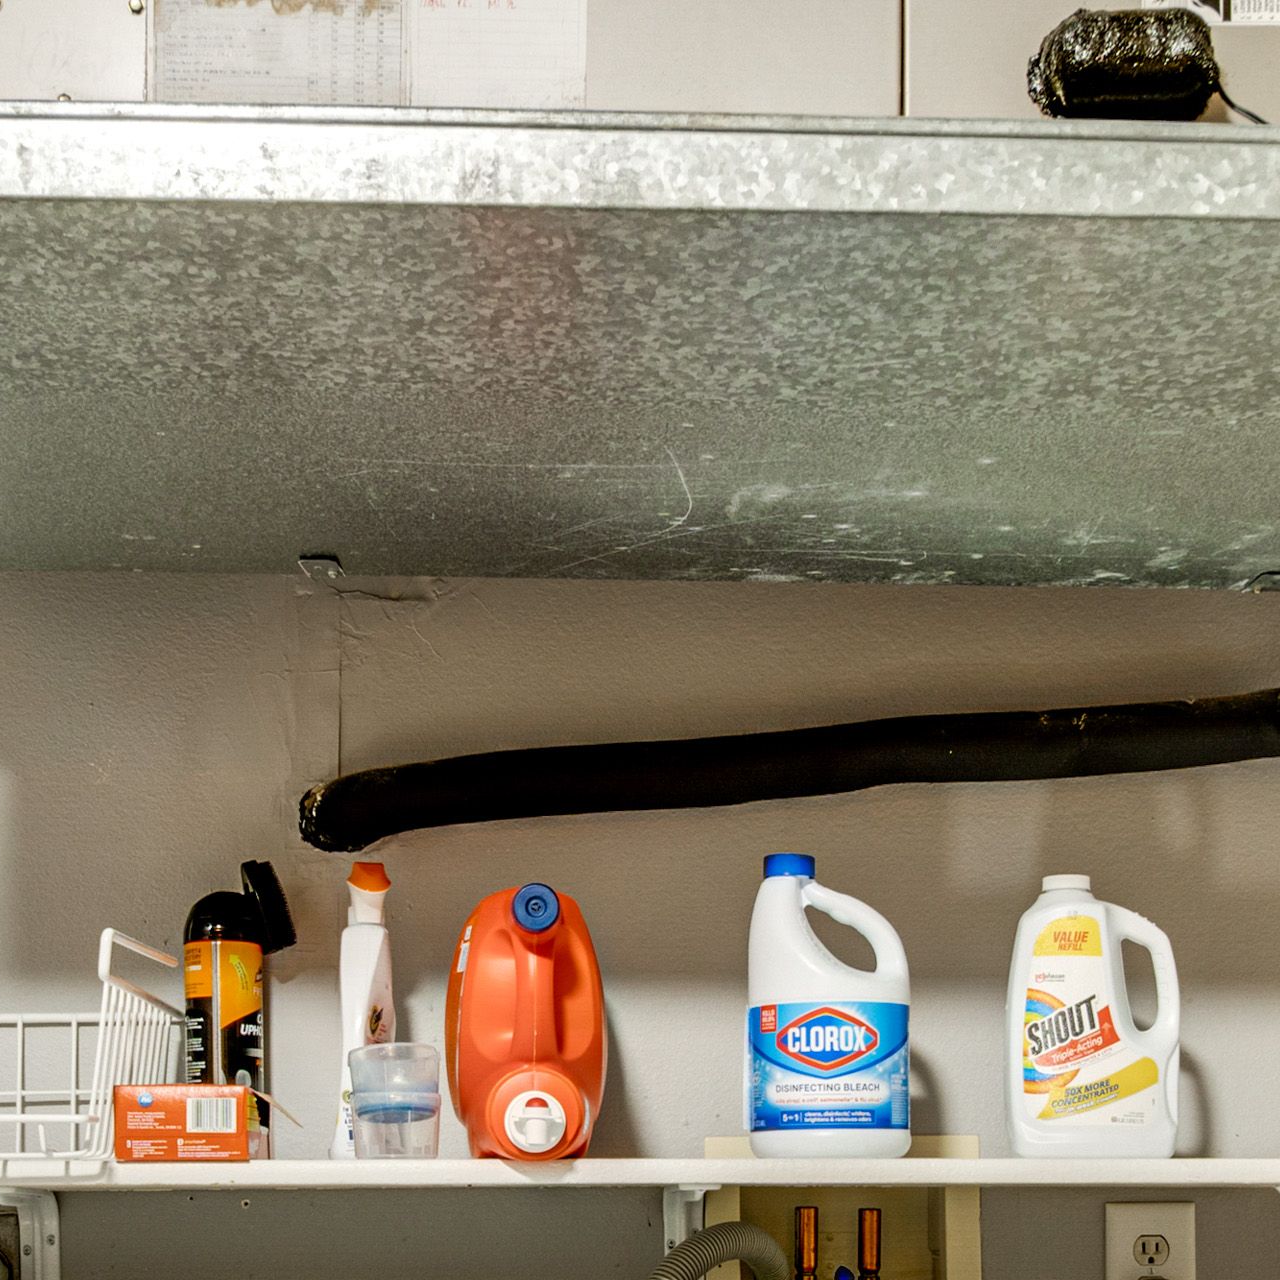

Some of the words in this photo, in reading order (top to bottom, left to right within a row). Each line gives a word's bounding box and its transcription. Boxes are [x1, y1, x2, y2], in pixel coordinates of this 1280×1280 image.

[1053, 931, 1089, 943] VALUE
[1058, 944, 1083, 952] REFILL
[1027, 994, 1096, 1056] SHOUT
[787, 1026, 866, 1052] CLOROX
[1051, 1035, 1104, 1063] Triple-Acting
[776, 1083, 841, 1093] DISINFECTING
[844, 1083, 880, 1092] BLEACH
[1083, 1079, 1110, 1093] MORE
[1051, 1084, 1120, 1108] CONCENTRATED
